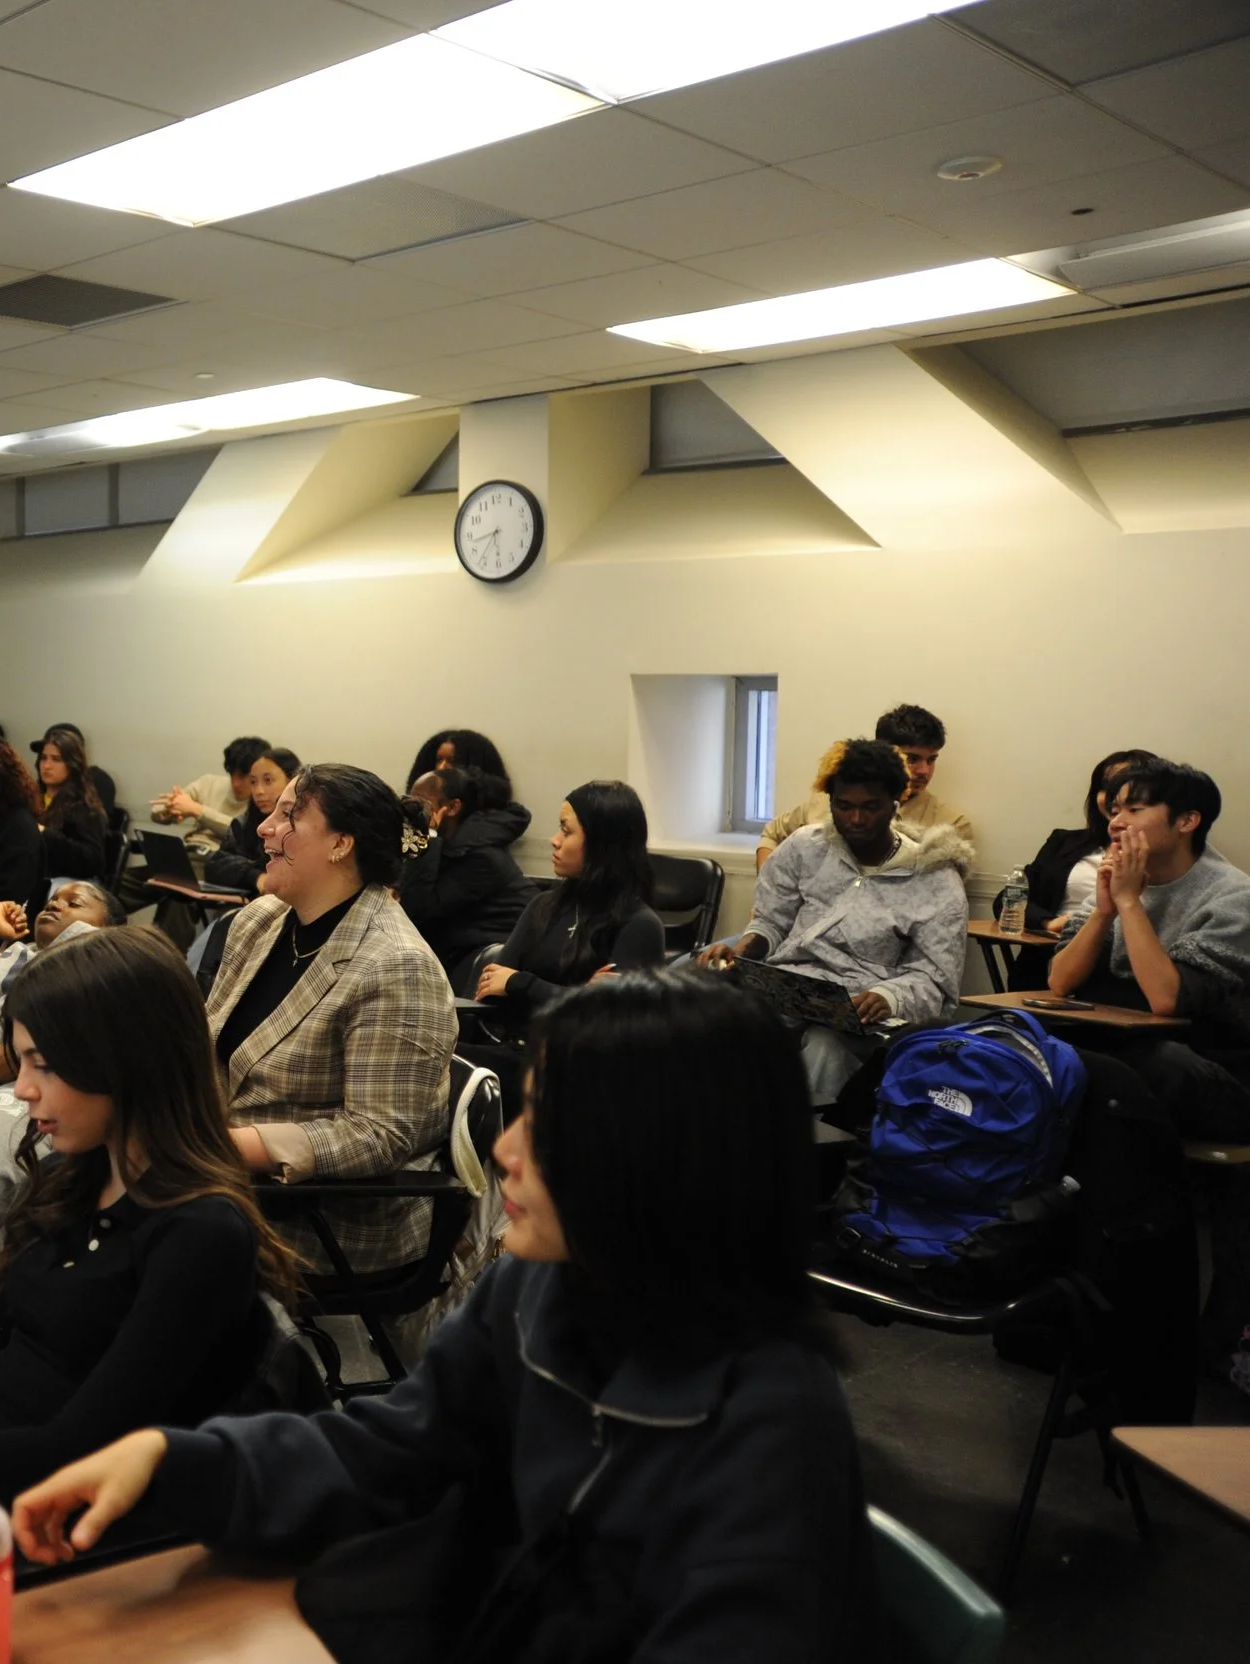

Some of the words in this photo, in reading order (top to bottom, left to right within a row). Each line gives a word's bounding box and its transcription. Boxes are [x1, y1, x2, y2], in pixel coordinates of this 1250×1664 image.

[492, 494, 502, 504] 12
[509, 497, 513, 506] 1
[480, 501, 488, 512] 11
[472, 516, 481, 526] 10
[928, 1089, 957, 1105] NORTH
[941, 1085, 960, 1098] THE
[934, 1098, 958, 1112] FACE
